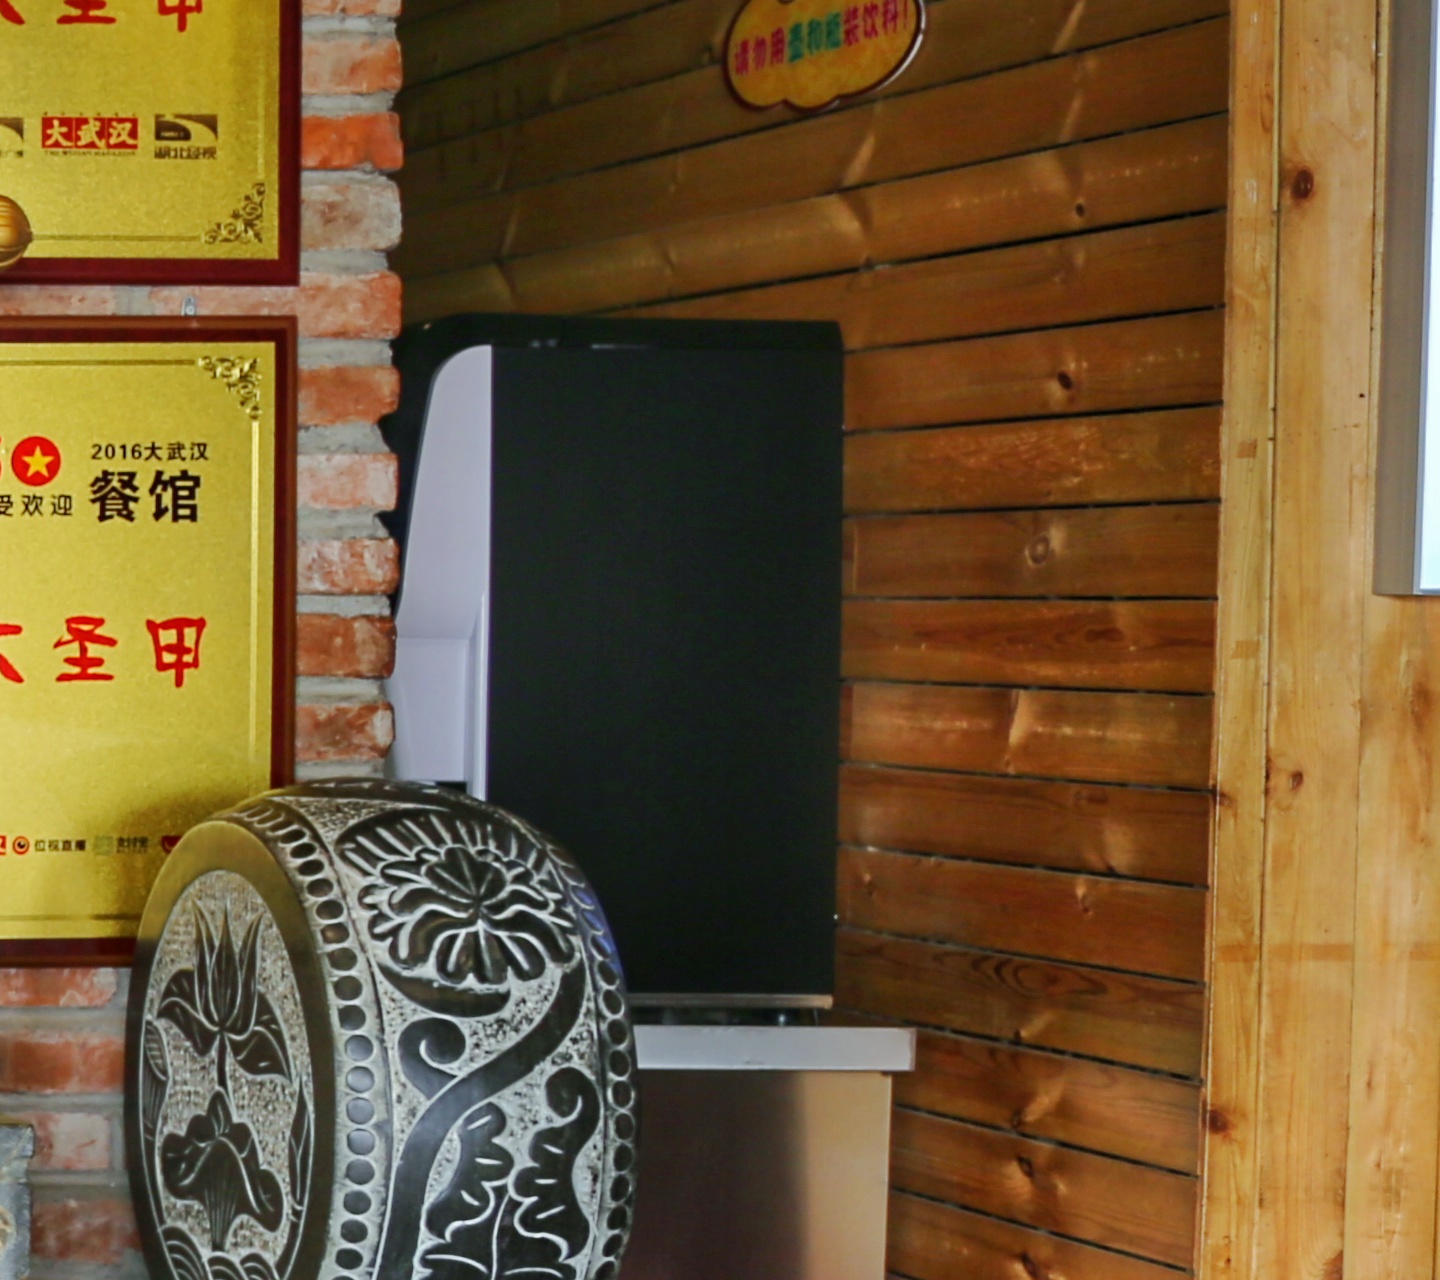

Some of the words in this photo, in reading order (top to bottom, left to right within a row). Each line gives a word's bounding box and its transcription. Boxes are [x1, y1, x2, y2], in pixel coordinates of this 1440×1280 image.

[44, 118, 138, 149] 大武汉
[91, 440, 210, 462] 2016大武汉
[89, 468, 203, 524] 餐馆
